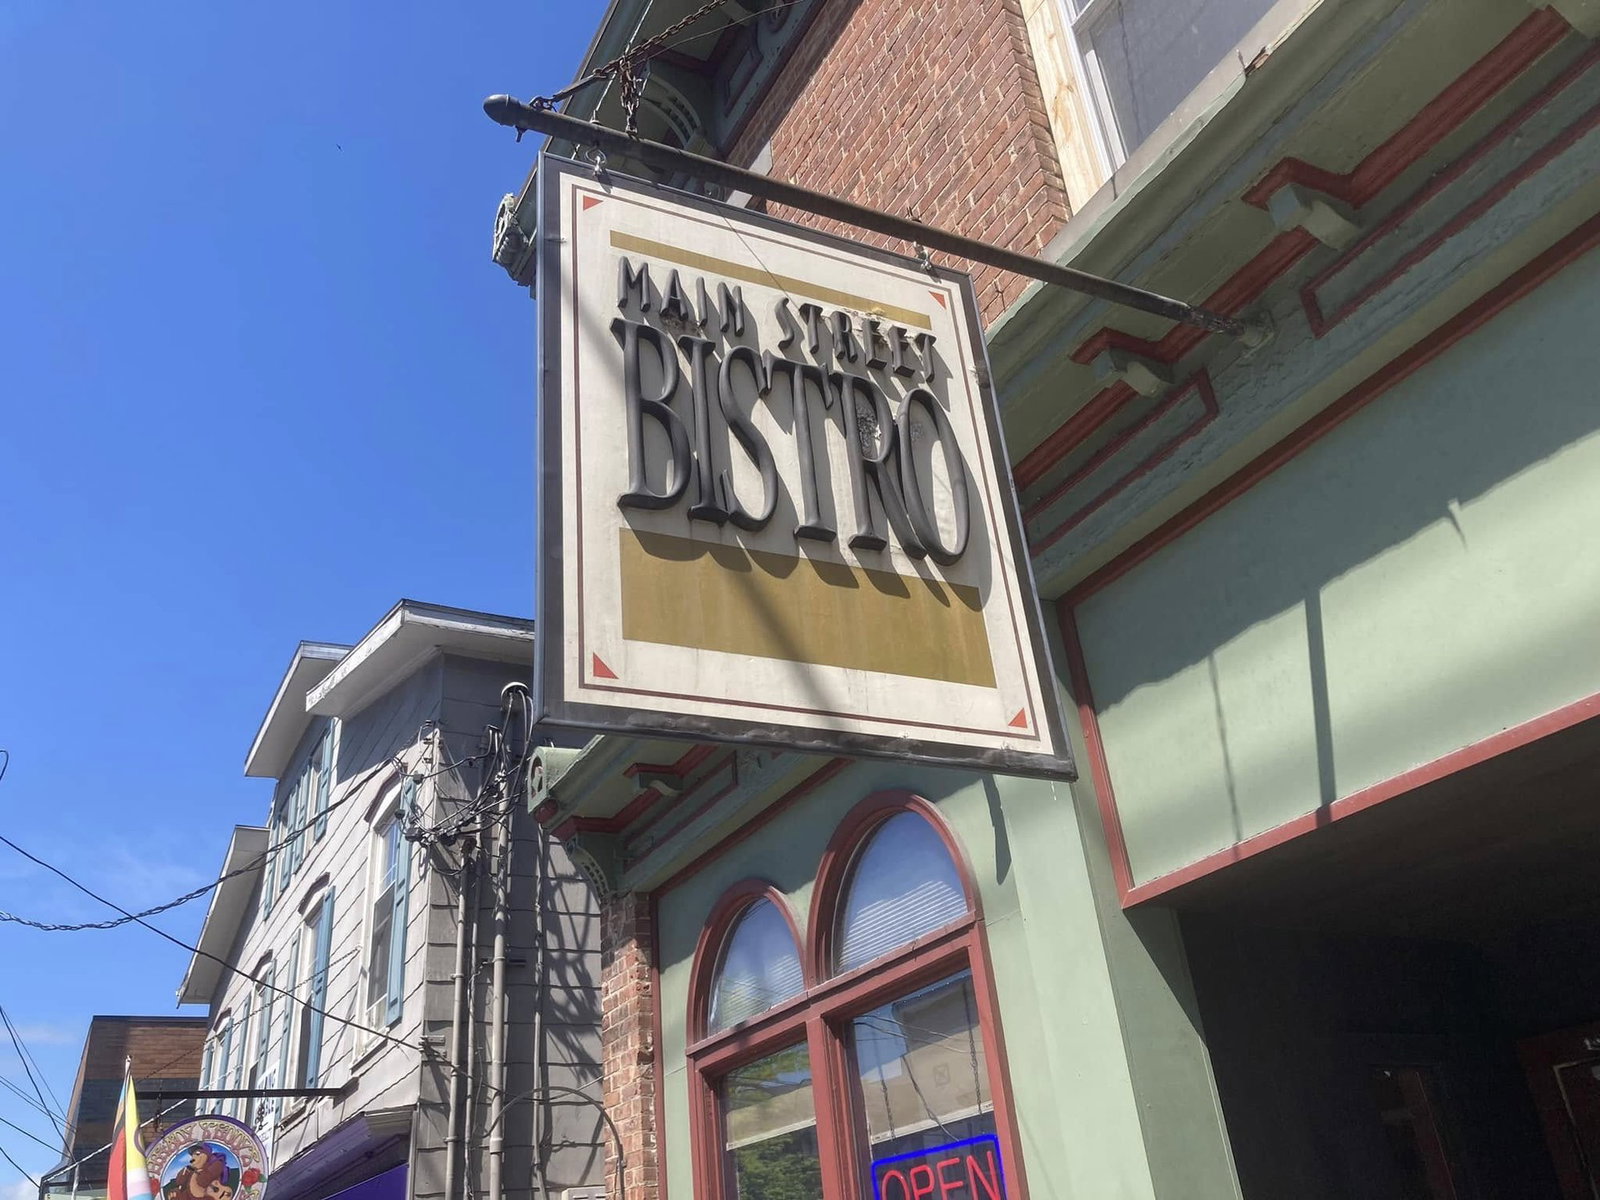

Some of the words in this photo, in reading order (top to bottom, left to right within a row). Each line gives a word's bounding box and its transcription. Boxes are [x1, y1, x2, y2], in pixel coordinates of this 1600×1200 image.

[617, 255, 745, 337] MAIN
[774, 297, 937, 384] STREET
[609, 317, 971, 567] BISTRO
[881, 1150, 1001, 1200] OPEN
